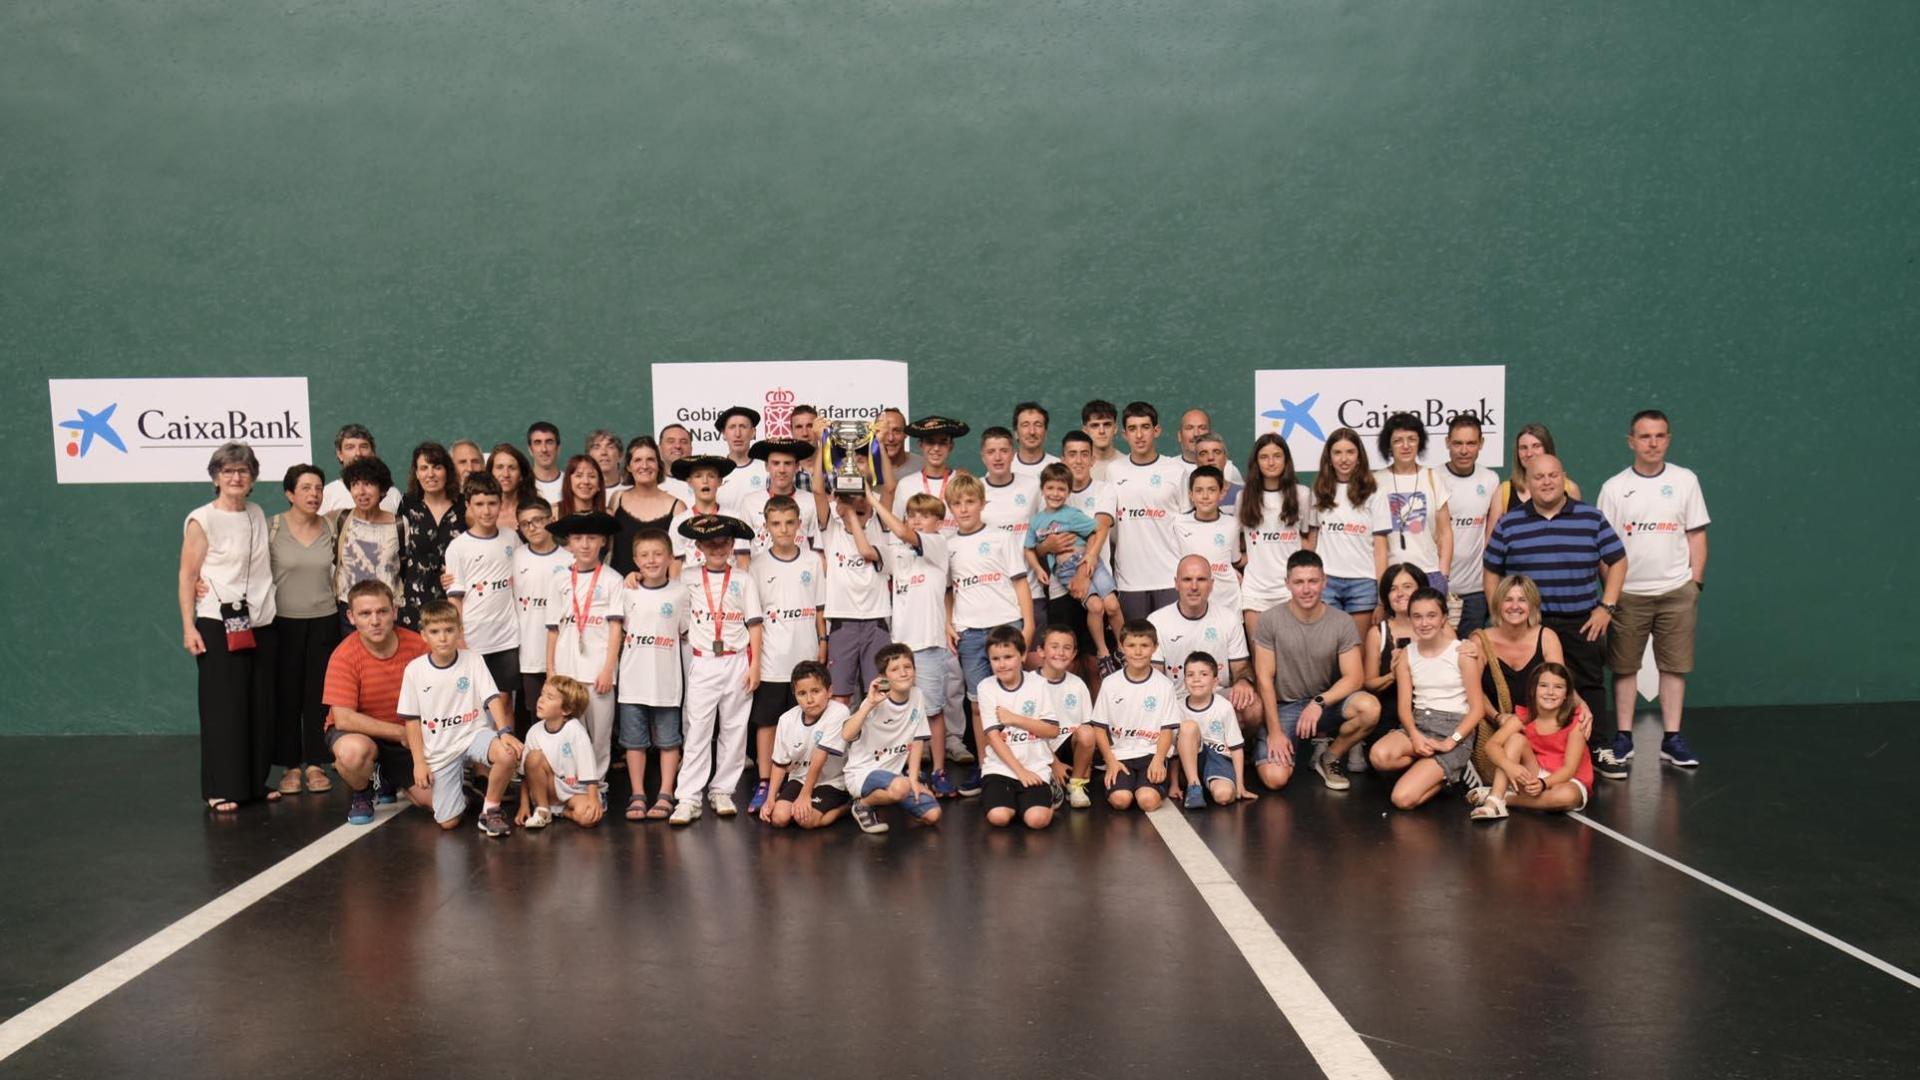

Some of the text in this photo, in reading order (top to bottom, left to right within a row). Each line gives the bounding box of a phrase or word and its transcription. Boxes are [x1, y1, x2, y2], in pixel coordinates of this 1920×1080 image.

[677, 407, 725, 421] Gobi
[1337, 398, 1496, 428] CaiBak
[137, 409, 303, 440] CaixaBank
[1128, 508, 1166, 518] TECMAC
[1327, 522, 1367, 534] TECMAC
[1637, 522, 1679, 532] TECMAC
[962, 572, 1002, 587] TECMAC
[636, 635, 675, 647] TECMAC
[889, 744, 912, 755] TEC
